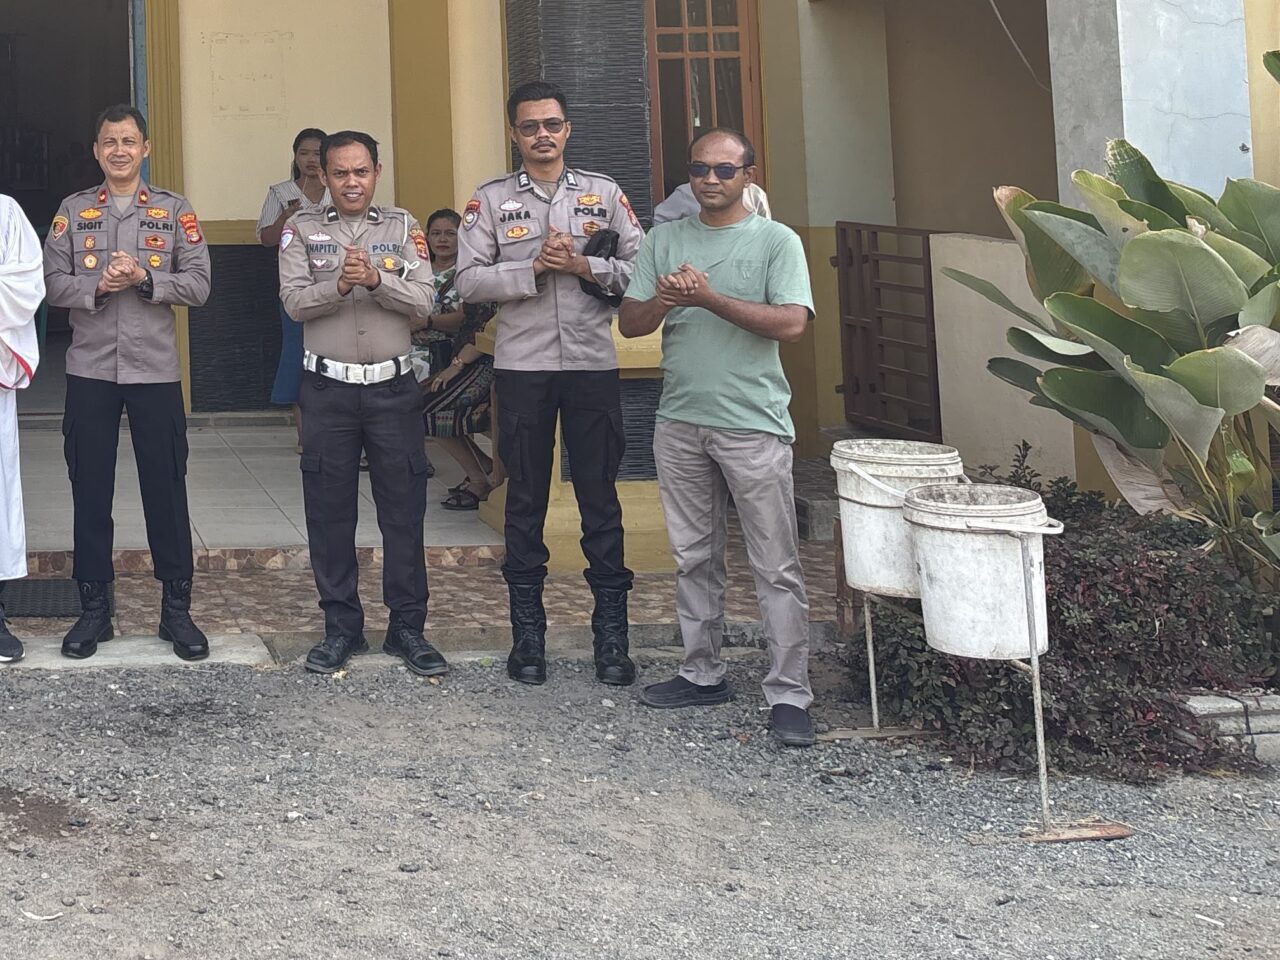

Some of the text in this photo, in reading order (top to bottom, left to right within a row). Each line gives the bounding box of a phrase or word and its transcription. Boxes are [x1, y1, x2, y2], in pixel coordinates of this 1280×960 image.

[500, 210, 531, 222] JAKA
[574, 207, 606, 218] POLRI
[76, 221, 103, 230] SIGIT
[140, 221, 173, 231] POLRI
